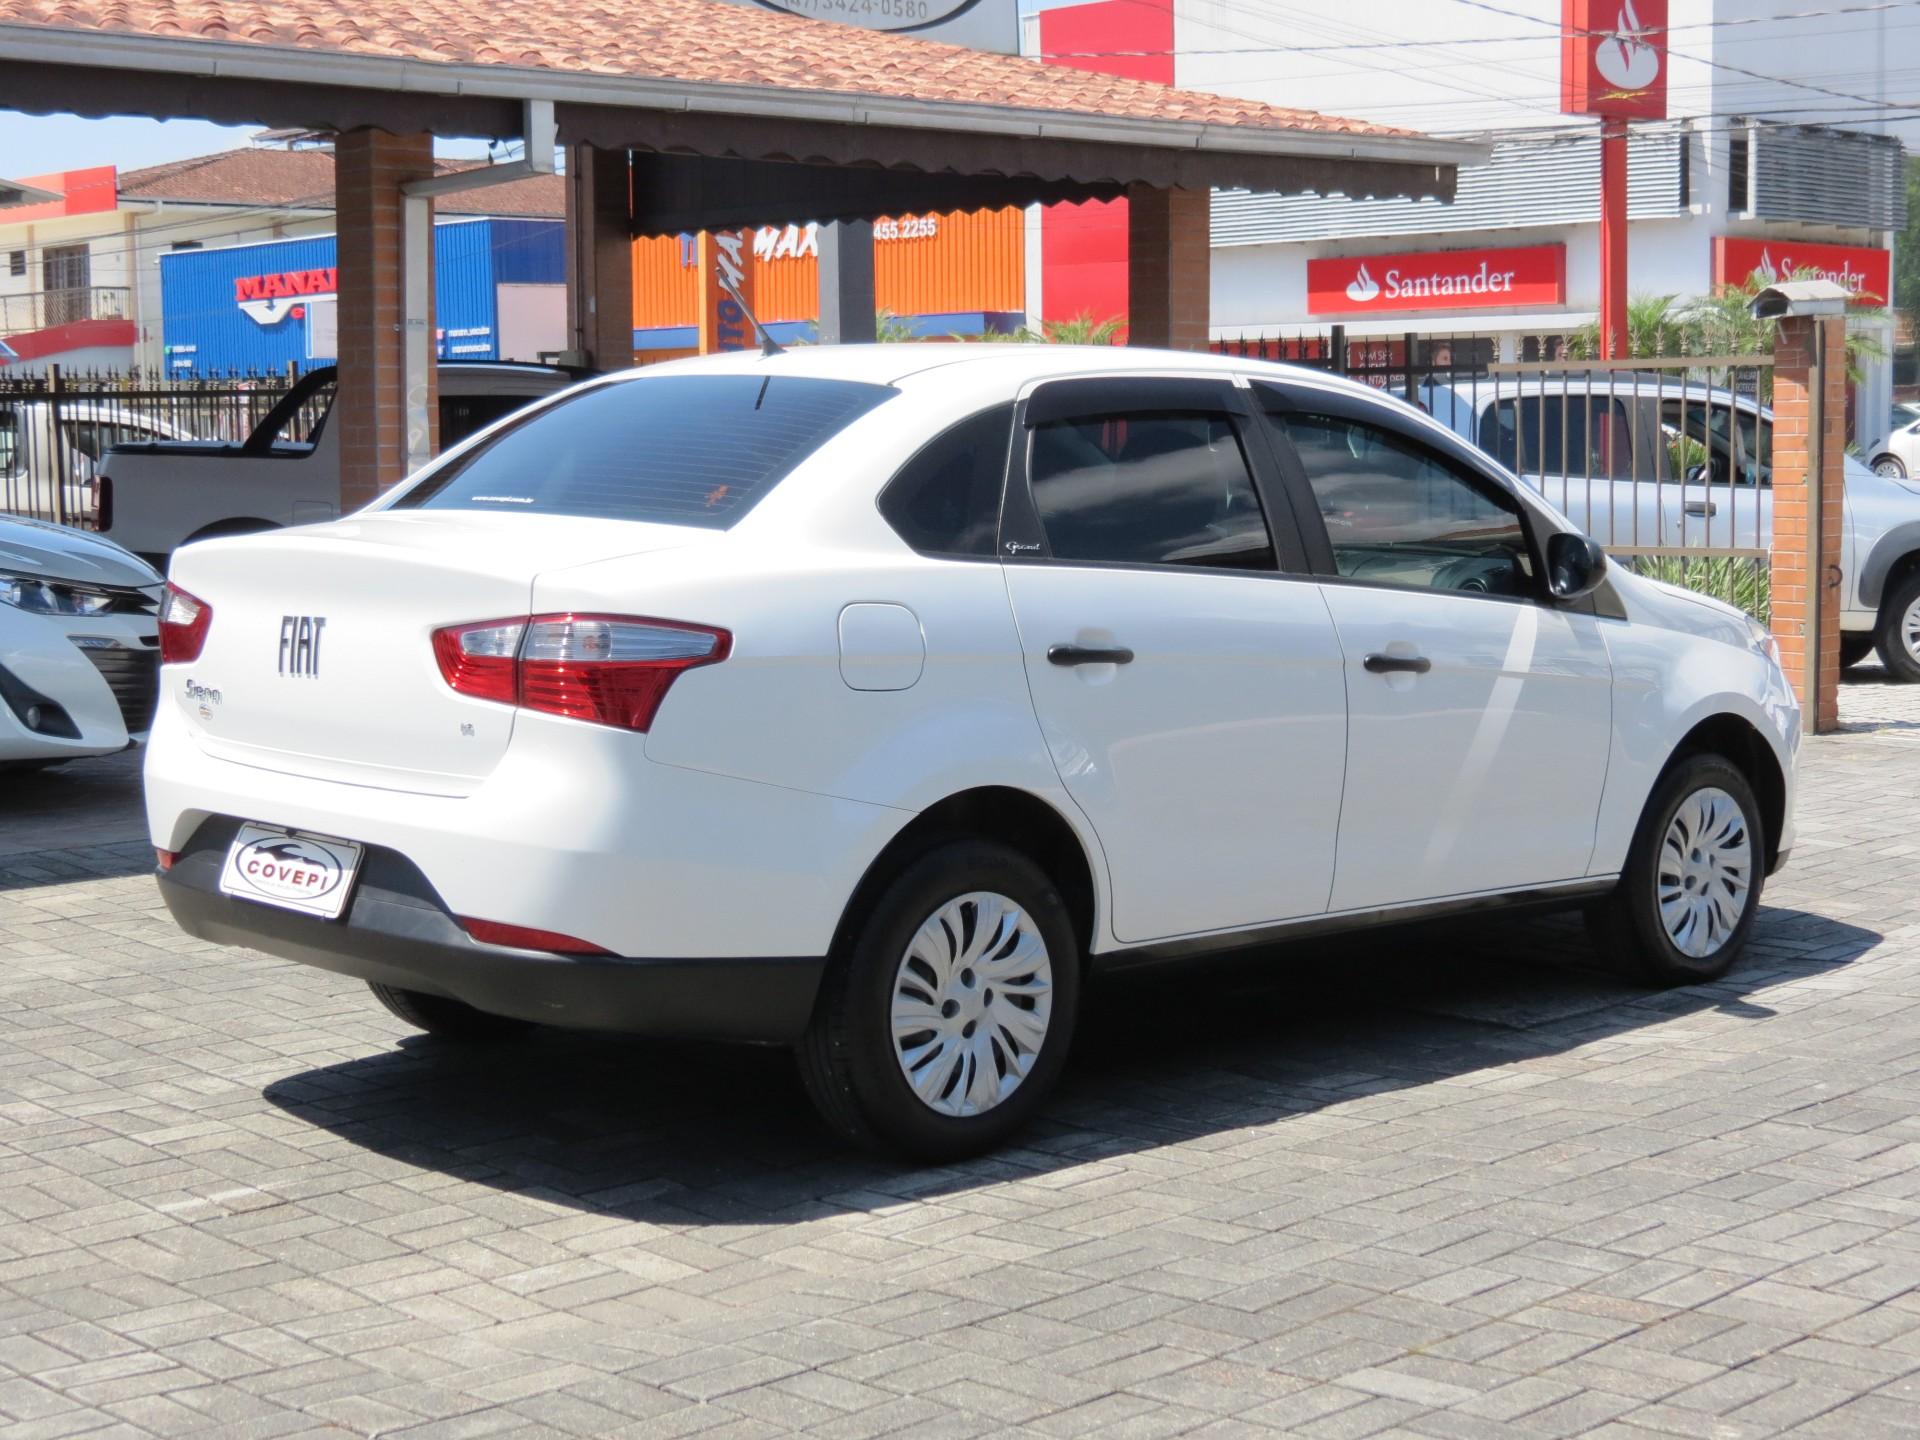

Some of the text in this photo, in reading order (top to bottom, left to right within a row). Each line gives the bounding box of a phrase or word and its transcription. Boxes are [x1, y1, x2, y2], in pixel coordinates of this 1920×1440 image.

[1385, 262, 1515, 299] Santander
[278, 615, 327, 676] FIAT
[246, 859, 329, 891] COVEPI
